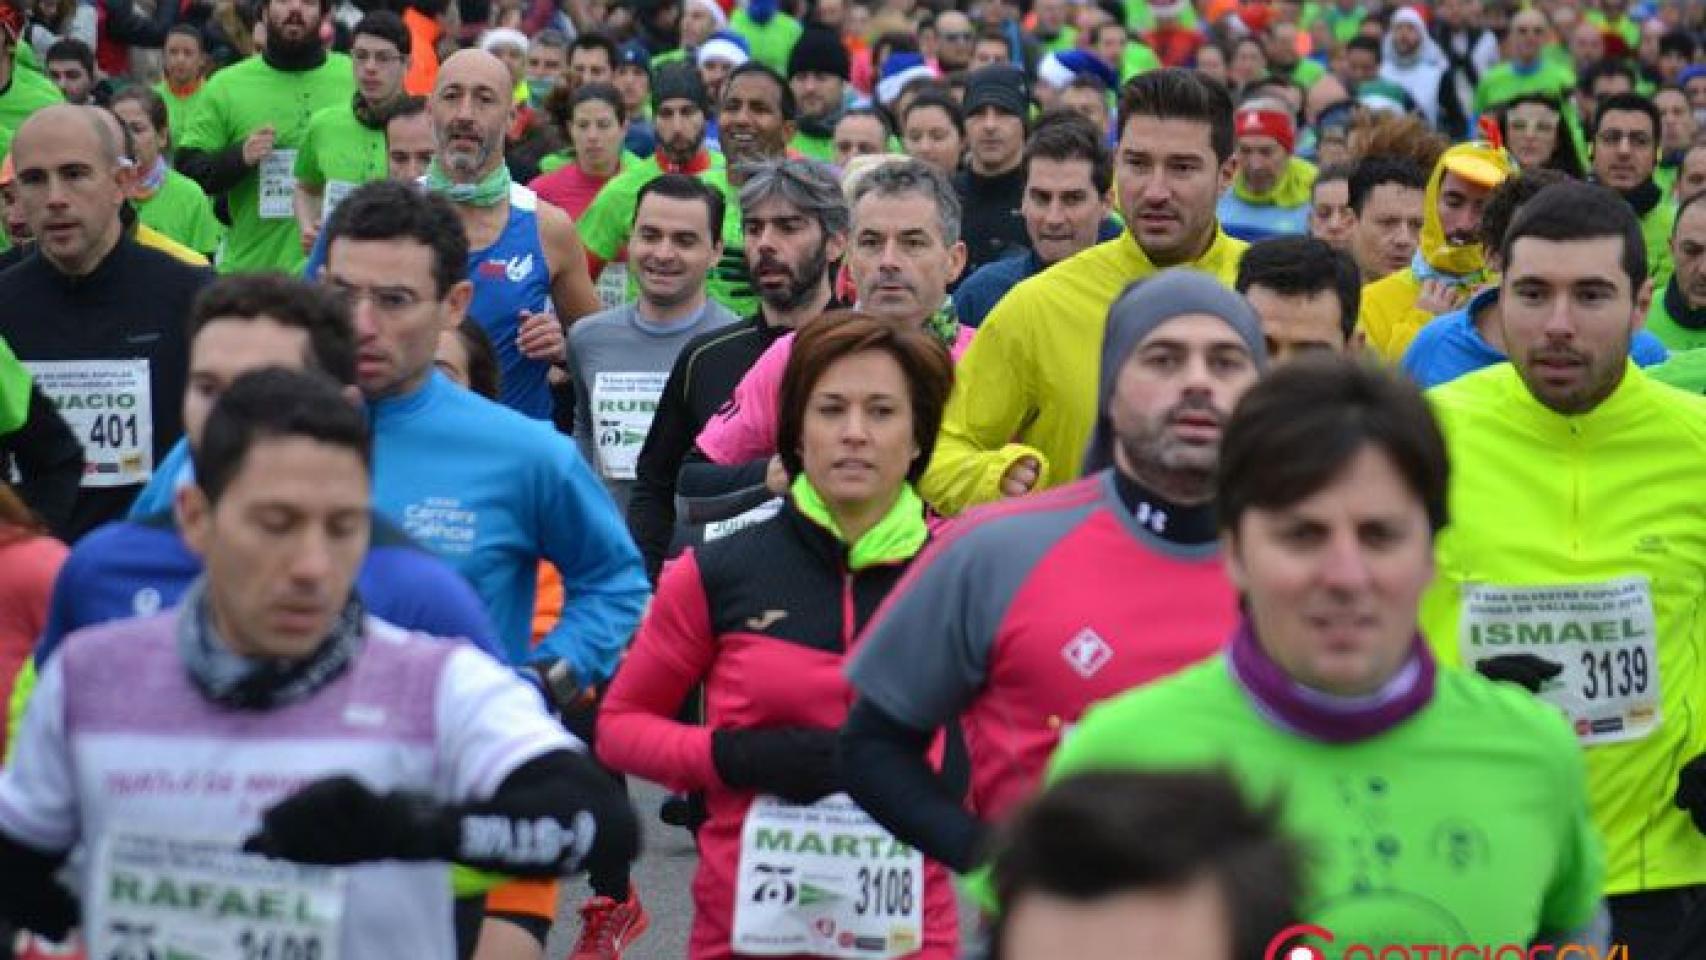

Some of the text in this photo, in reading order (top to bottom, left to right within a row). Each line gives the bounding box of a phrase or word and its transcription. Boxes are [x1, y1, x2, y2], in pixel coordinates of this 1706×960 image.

[90, 413, 138, 448] 401
[1470, 617, 1647, 645] ISMAEL
[1581, 646, 1648, 699] 3139
[755, 827, 914, 859] MARTA
[109, 872, 328, 925] RAFAEL
[855, 866, 914, 917] 3108
